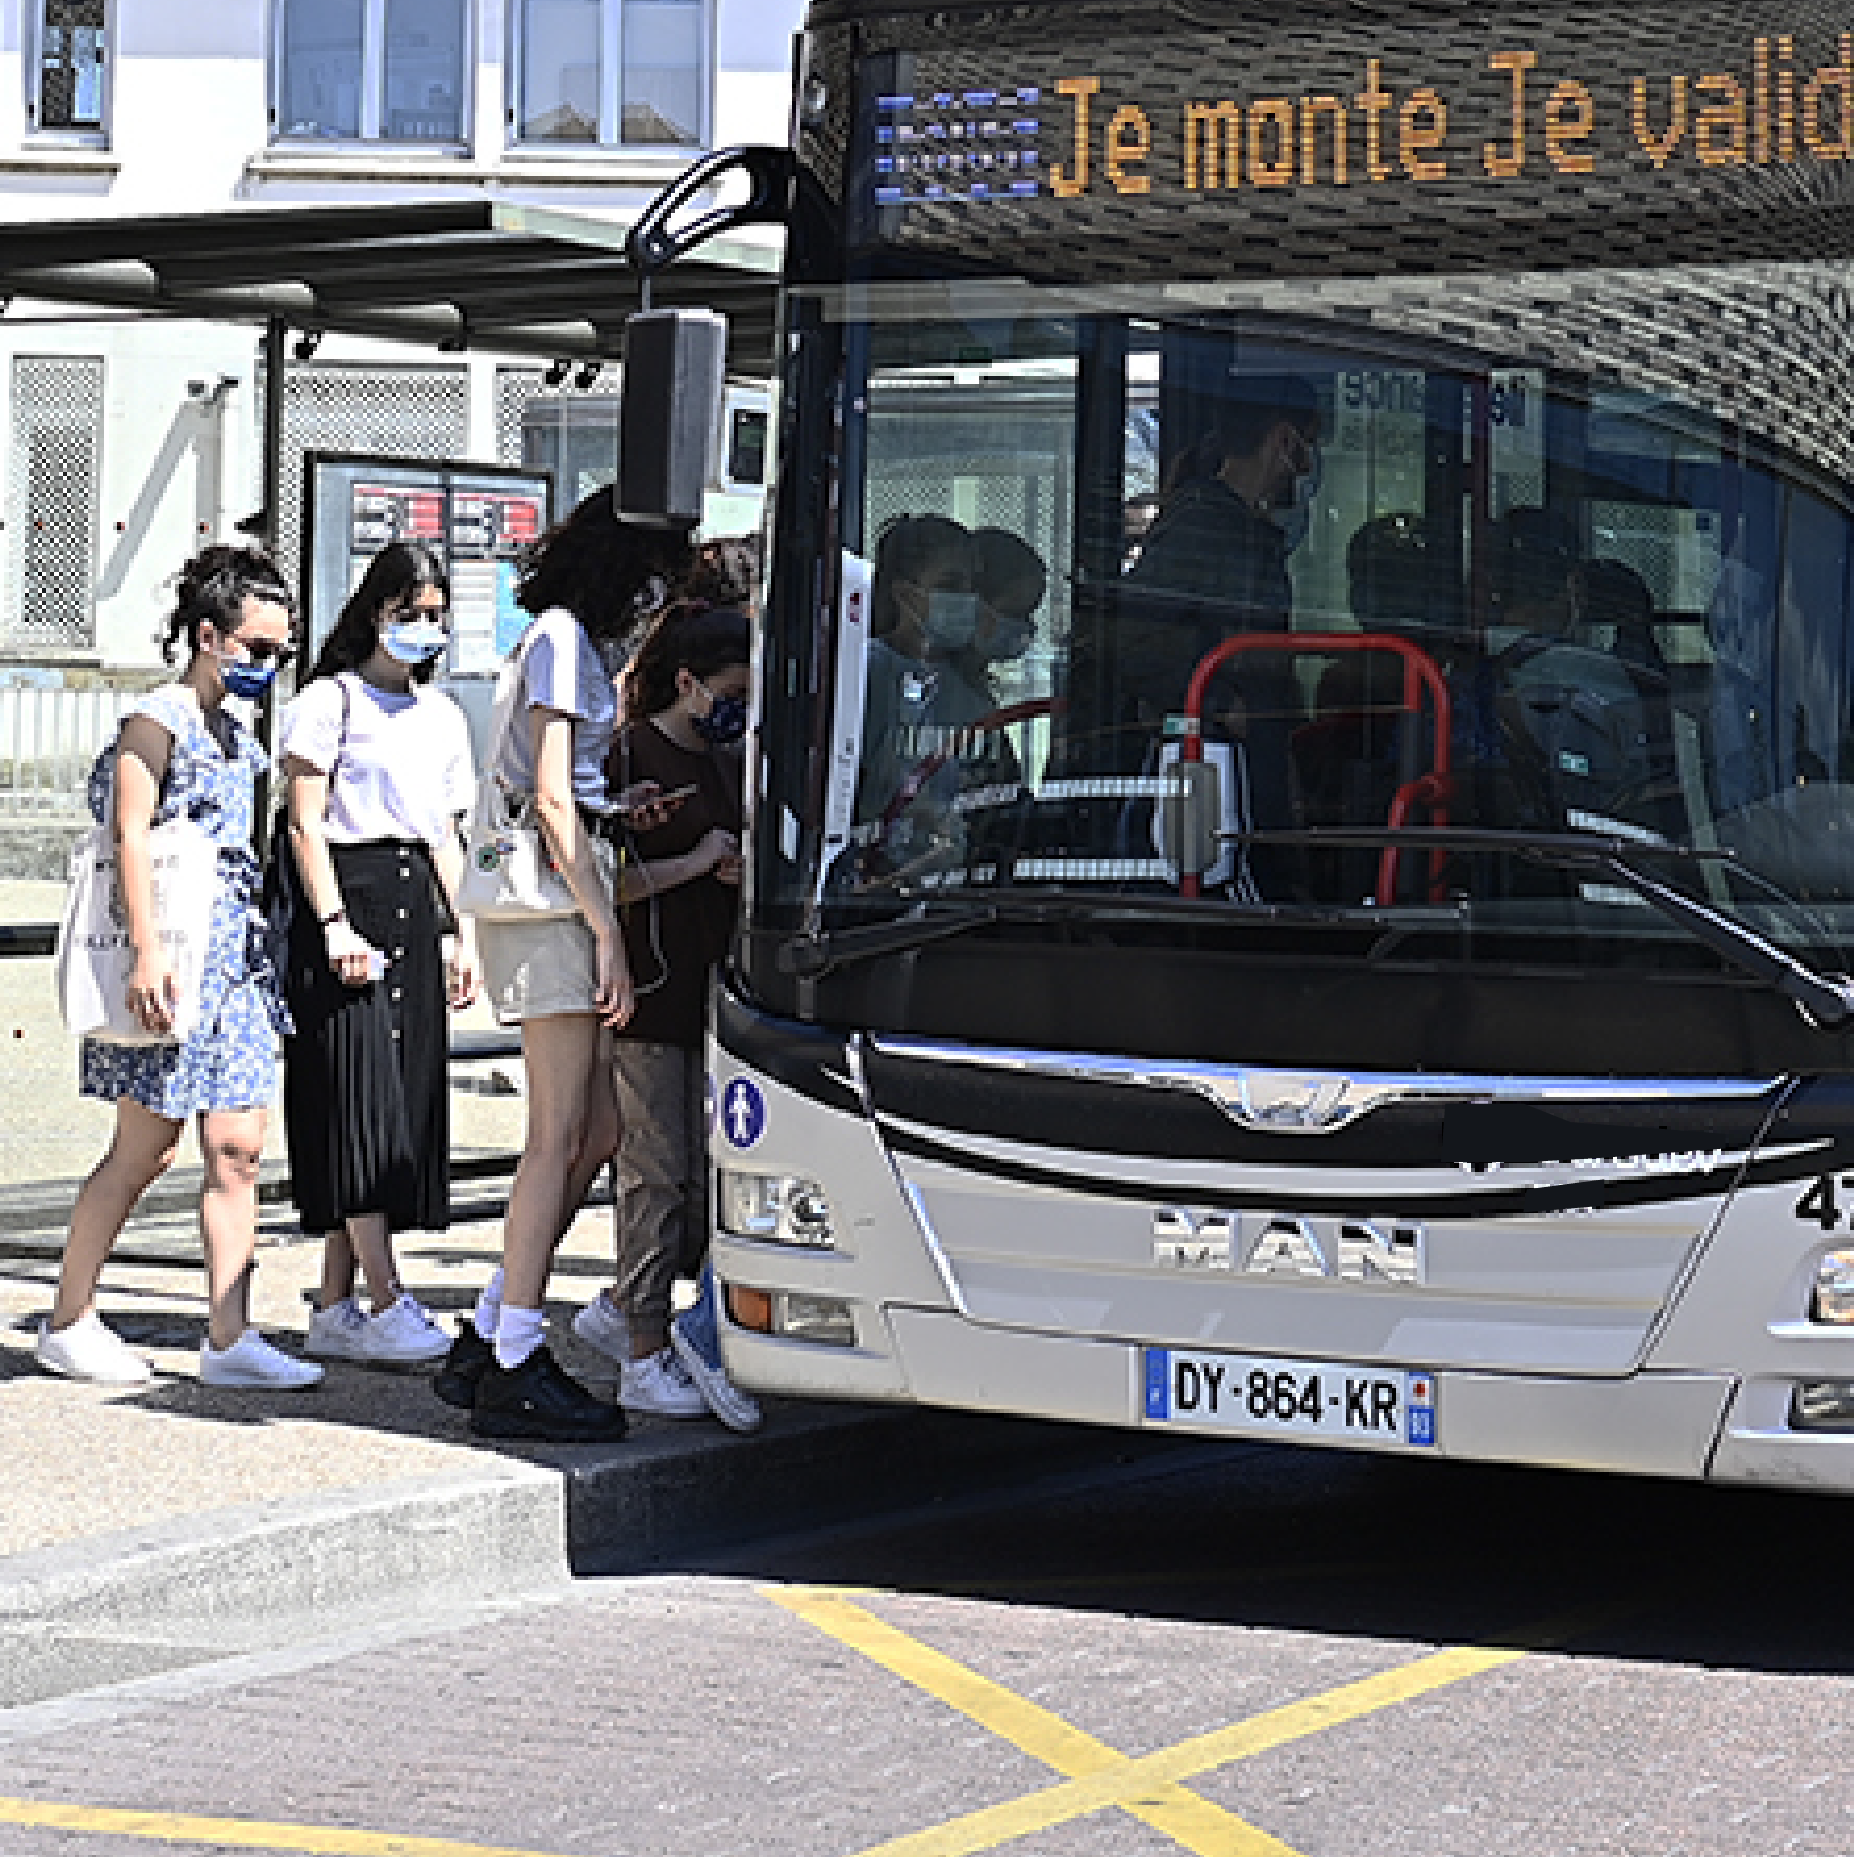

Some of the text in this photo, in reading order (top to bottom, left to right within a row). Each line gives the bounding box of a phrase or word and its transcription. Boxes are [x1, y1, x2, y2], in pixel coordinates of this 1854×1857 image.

[1048, 75, 1151, 198] Je
[1182, 57, 1448, 190] monte
[1483, 49, 1594, 178] Je
[1150, 1205, 1428, 1285] MAN
[1176, 1360, 1399, 1433] DY-864-KR
